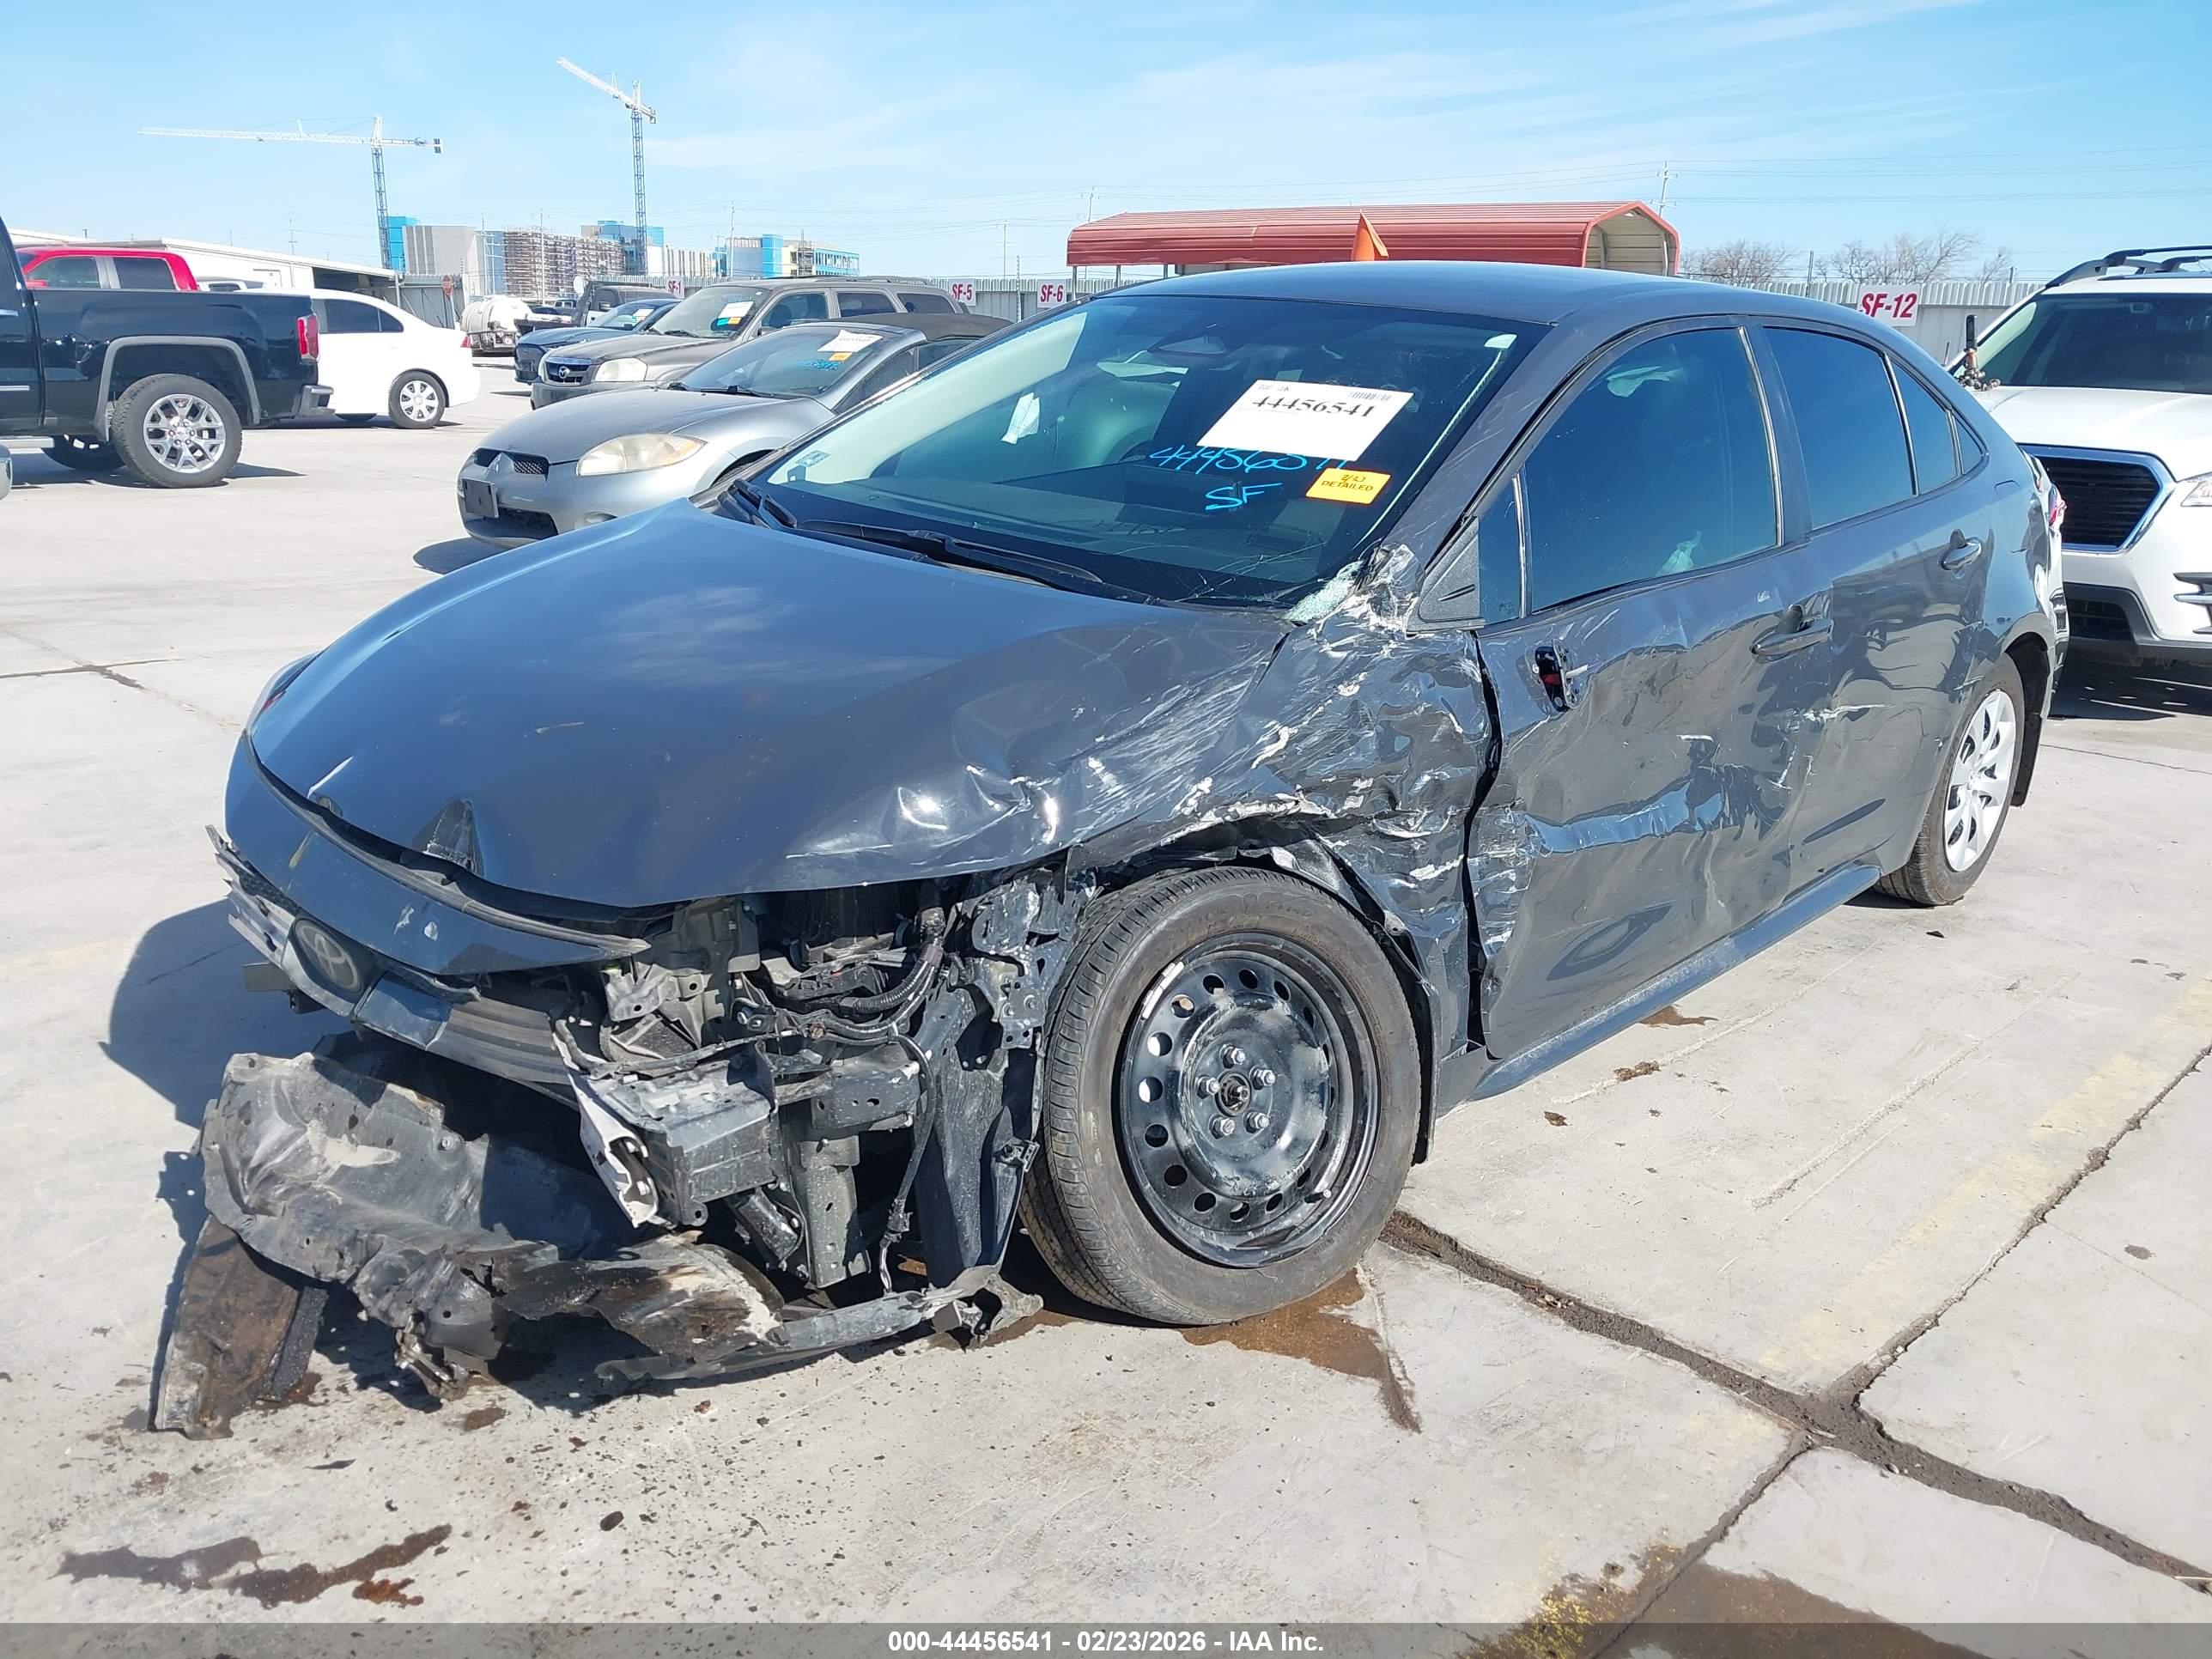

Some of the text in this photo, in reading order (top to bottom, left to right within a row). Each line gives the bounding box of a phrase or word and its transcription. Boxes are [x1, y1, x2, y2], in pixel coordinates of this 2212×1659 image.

[951, 283, 972, 301] SF-5
[1040, 284, 1064, 302] SF-6
[1859, 293, 1917, 318] SF-12
[1252, 396, 1375, 417] 44456541
[1321, 480, 1374, 492] DETAILED
[1205, 483, 1283, 510] SF
